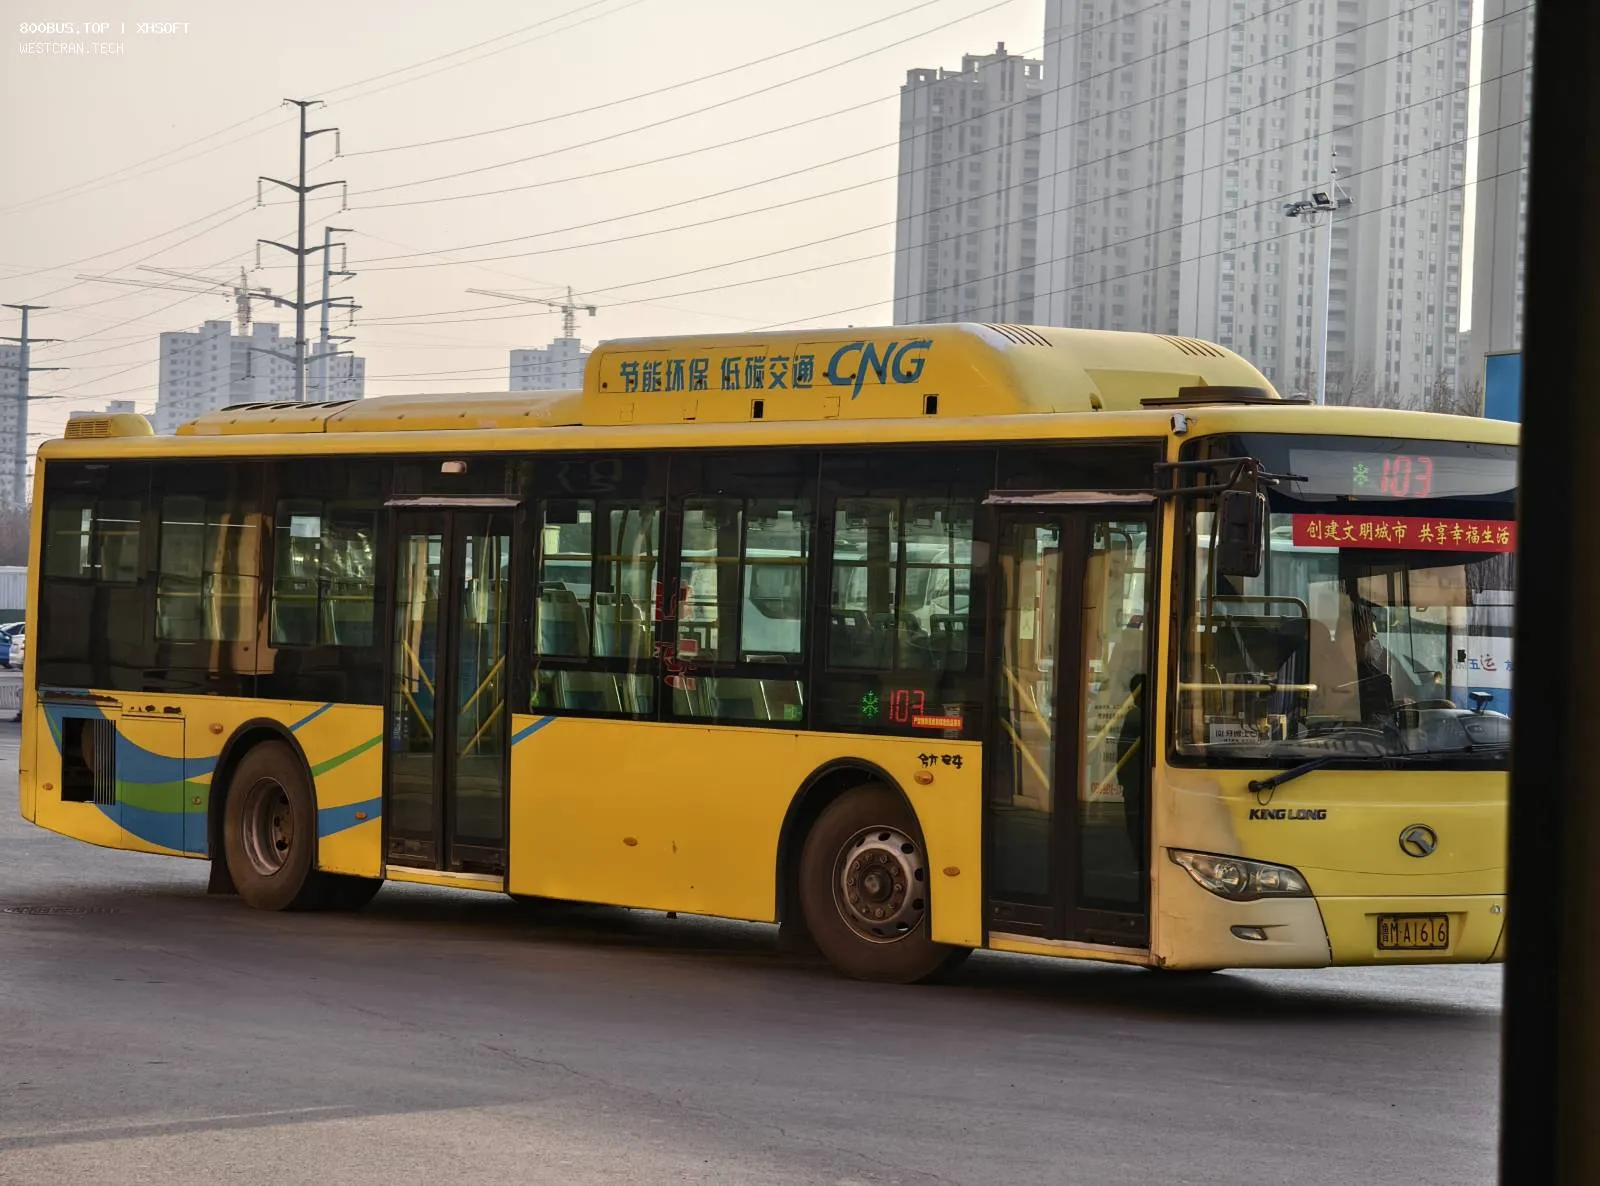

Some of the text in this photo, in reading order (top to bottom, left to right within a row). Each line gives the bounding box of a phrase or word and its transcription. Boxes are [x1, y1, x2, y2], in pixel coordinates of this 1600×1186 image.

[619, 354, 815, 393] 节能环保 低碳交通
[826, 339, 934, 401] CNG
[1380, 454, 1433, 498] 103
[1306, 519, 1511, 546] 创建文明城市 共享幸福生活
[889, 689, 925, 722] 103
[1248, 808, 1328, 821] KING LONG
